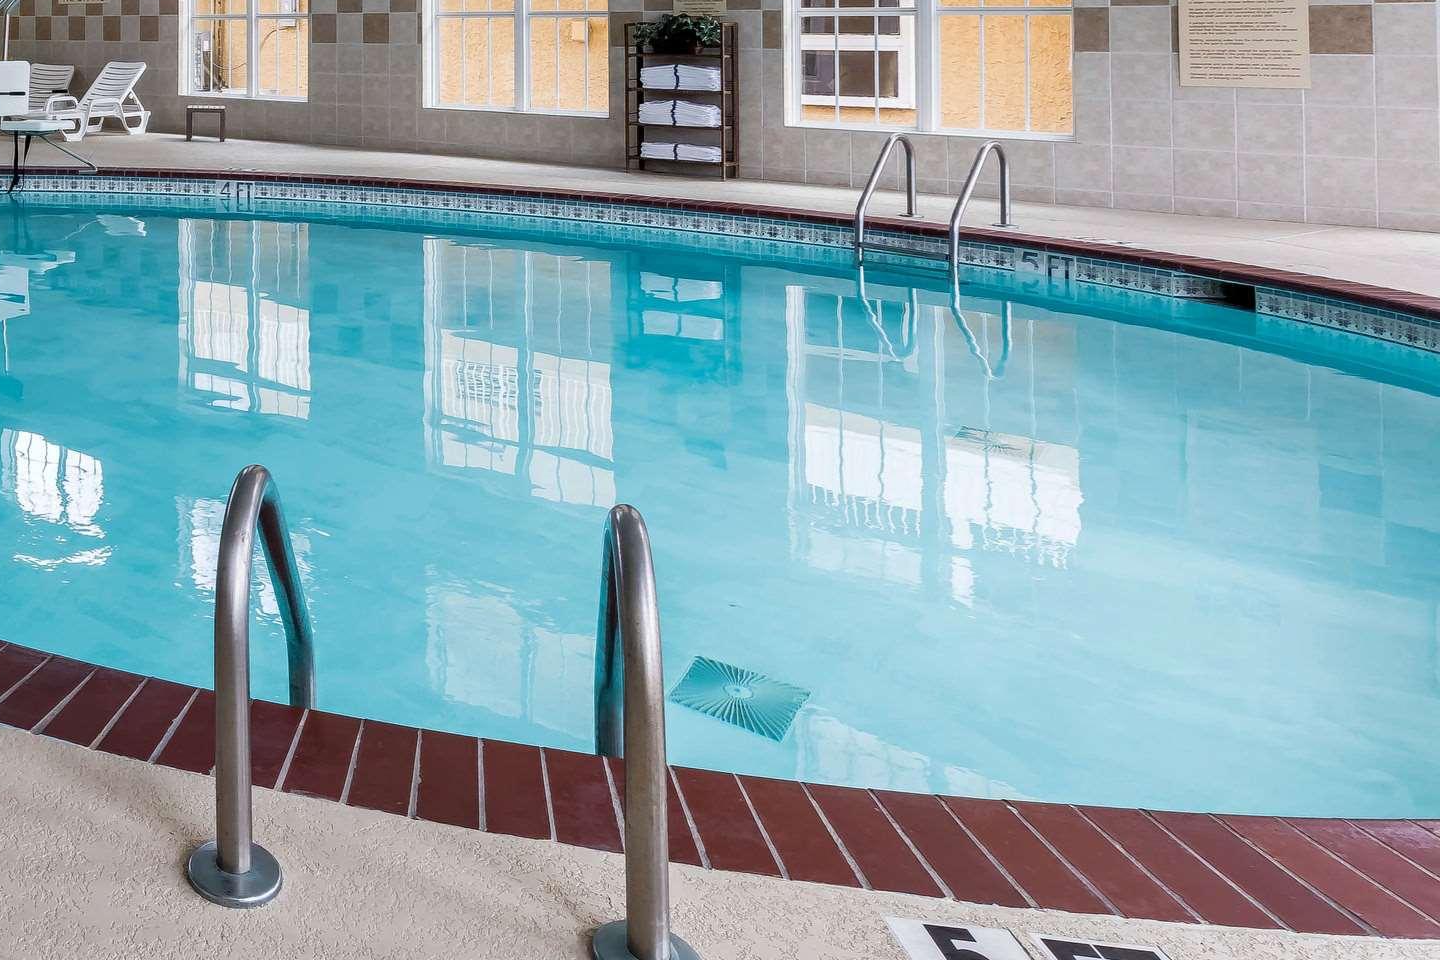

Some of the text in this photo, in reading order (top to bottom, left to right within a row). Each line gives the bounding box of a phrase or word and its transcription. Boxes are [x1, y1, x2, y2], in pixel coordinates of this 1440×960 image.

[220, 182, 254, 198] 4 FT
[1022, 251, 1073, 280] 5 FT
